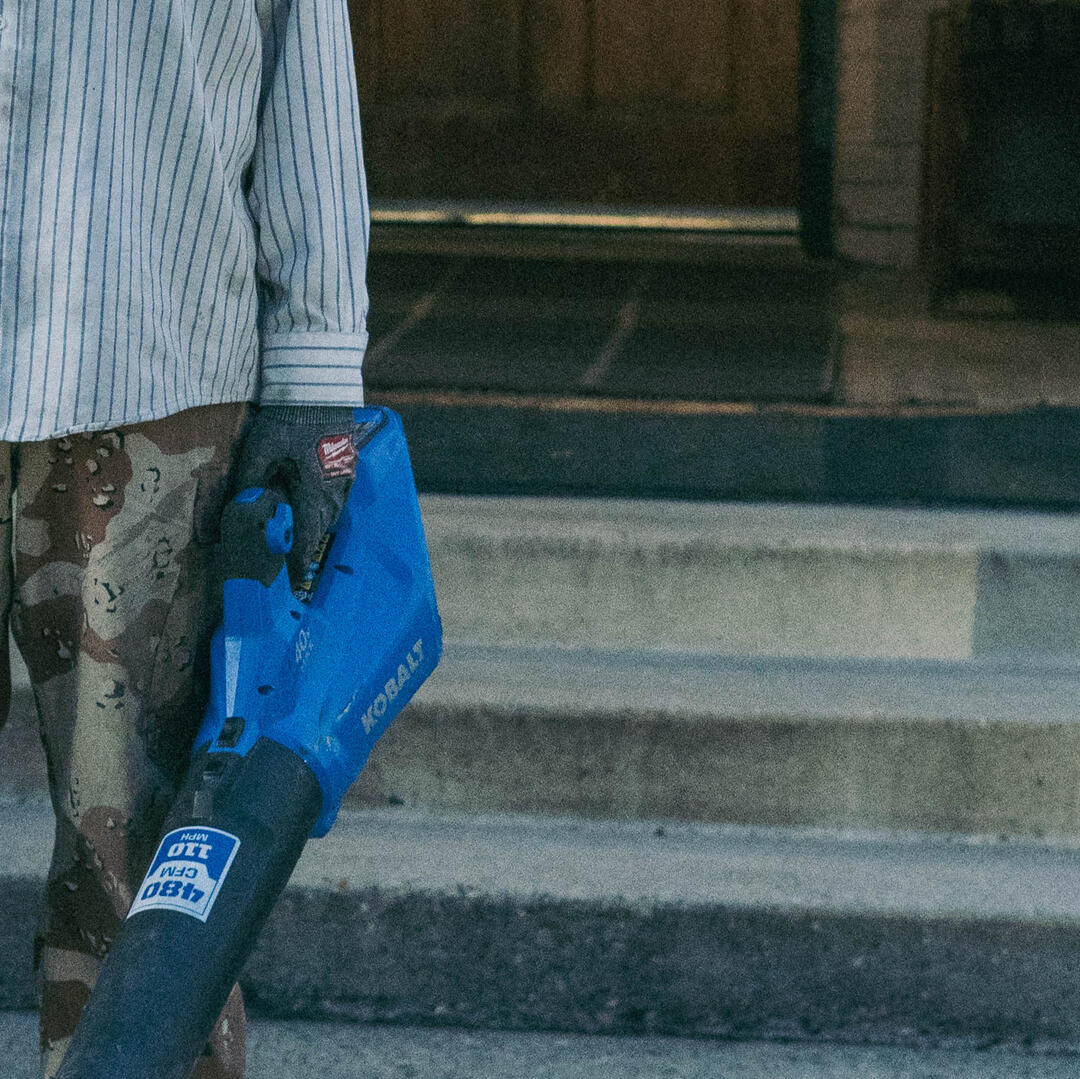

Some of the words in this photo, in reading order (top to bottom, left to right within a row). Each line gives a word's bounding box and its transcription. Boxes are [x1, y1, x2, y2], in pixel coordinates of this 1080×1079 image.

[361, 638, 424, 735] KOBALT
[179, 832, 209, 842] MPH
[166, 841, 213, 860] 110
[159, 865, 199, 879] CFM
[140, 880, 206, 904] 480
